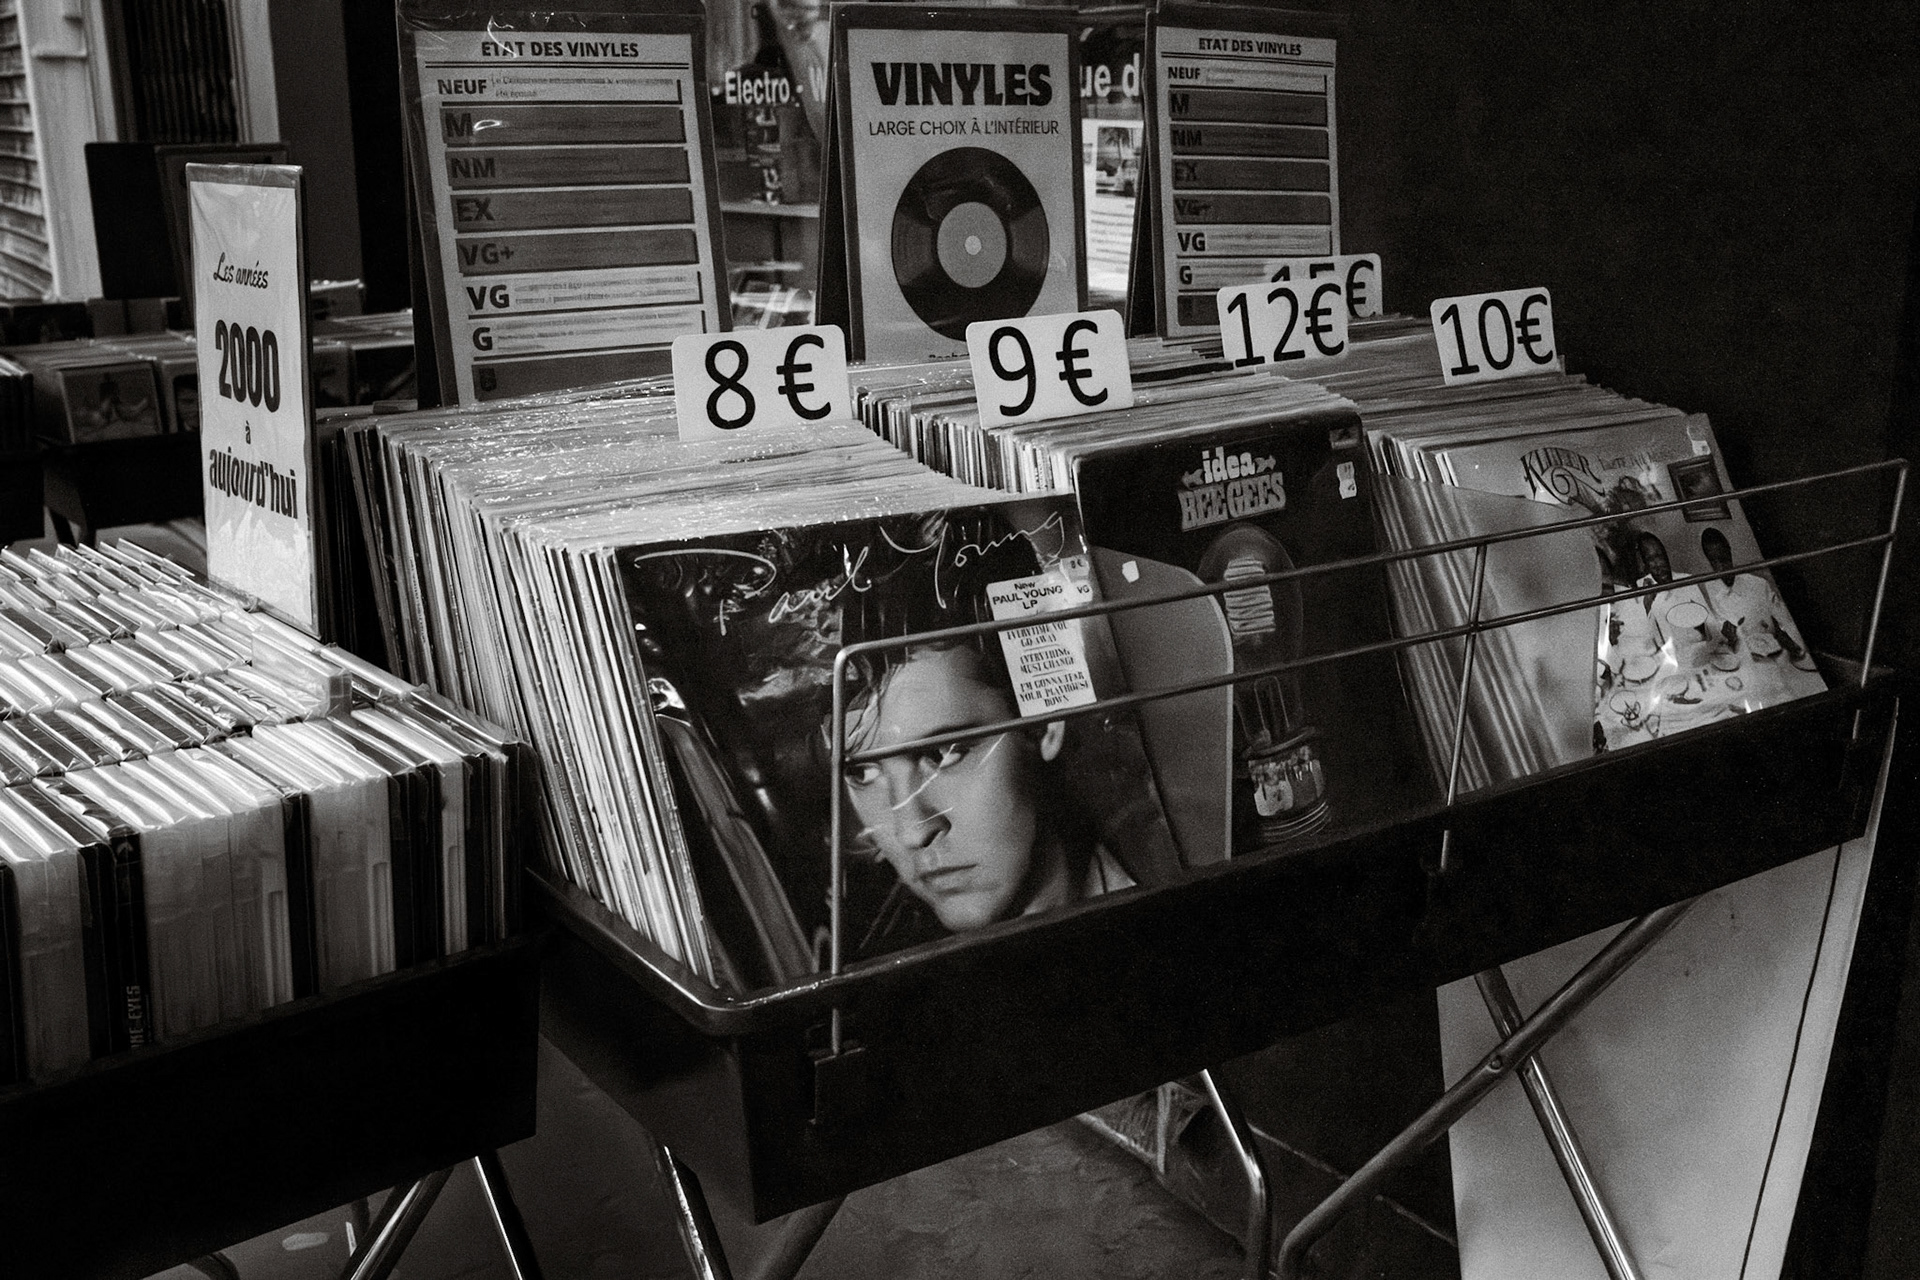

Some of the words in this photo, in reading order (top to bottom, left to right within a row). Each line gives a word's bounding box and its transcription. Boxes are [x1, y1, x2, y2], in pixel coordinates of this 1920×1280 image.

[481, 41, 525, 57] ETAT
[531, 41, 563, 57] DES
[567, 42, 639, 58] VINYLES
[1199, 37, 1229, 51] ETAT
[1231, 39, 1253, 53] DES
[1255, 41, 1302, 56] VINYLES
[870, 62, 1053, 106] VINYLES
[1168, 66, 1201, 80] NEUF
[437, 79, 487, 95] NEUF
[725, 71, 790, 105] Electro
[1171, 93, 1190, 115] M
[445, 112, 474, 138] M
[869, 120, 916, 136] LARGE
[920, 120, 966, 136] CHOIX
[971, 117, 981, 135] À
[985, 117, 1059, 136] L'INTÉRIEUR
[1172, 129, 1202, 147] NM
[451, 157, 496, 179] NM
[456, 198, 495, 222] EX
[1177, 232, 1206, 252] VG
[459, 242, 514, 266] VG+
[213, 251, 235, 283] Les
[235, 260, 269, 290] années
[1179, 265, 1193, 285] G
[466, 284, 510, 311] VG
[1227, 283, 1344, 368] 12€
[1440, 293, 1553, 377] 10€
[472, 326, 493, 351] G
[215, 319, 281, 414] 2000
[244, 419, 252, 445] à
[1202, 446, 1255, 484] idea
[209, 446, 298, 520] aujourd'hui
[1178, 483, 1228, 531] BEE
[1226, 472, 1286, 518] GEES
[992, 592, 1023, 605] PAUL
[1023, 585, 1063, 599] YOUNG
[1022, 599, 1038, 610] LP
[1006, 623, 1050, 640] EVERYTIME
[1019, 648, 1071, 664] EVERYTHING
[1020, 661, 1042, 674] MUST
[1043, 656, 1074, 671] CHANGE
[1019, 689, 1043, 702] YOUR
[1045, 680, 1089, 698] PLAYHOUSE
[1034, 675, 1063, 689] GONNA
